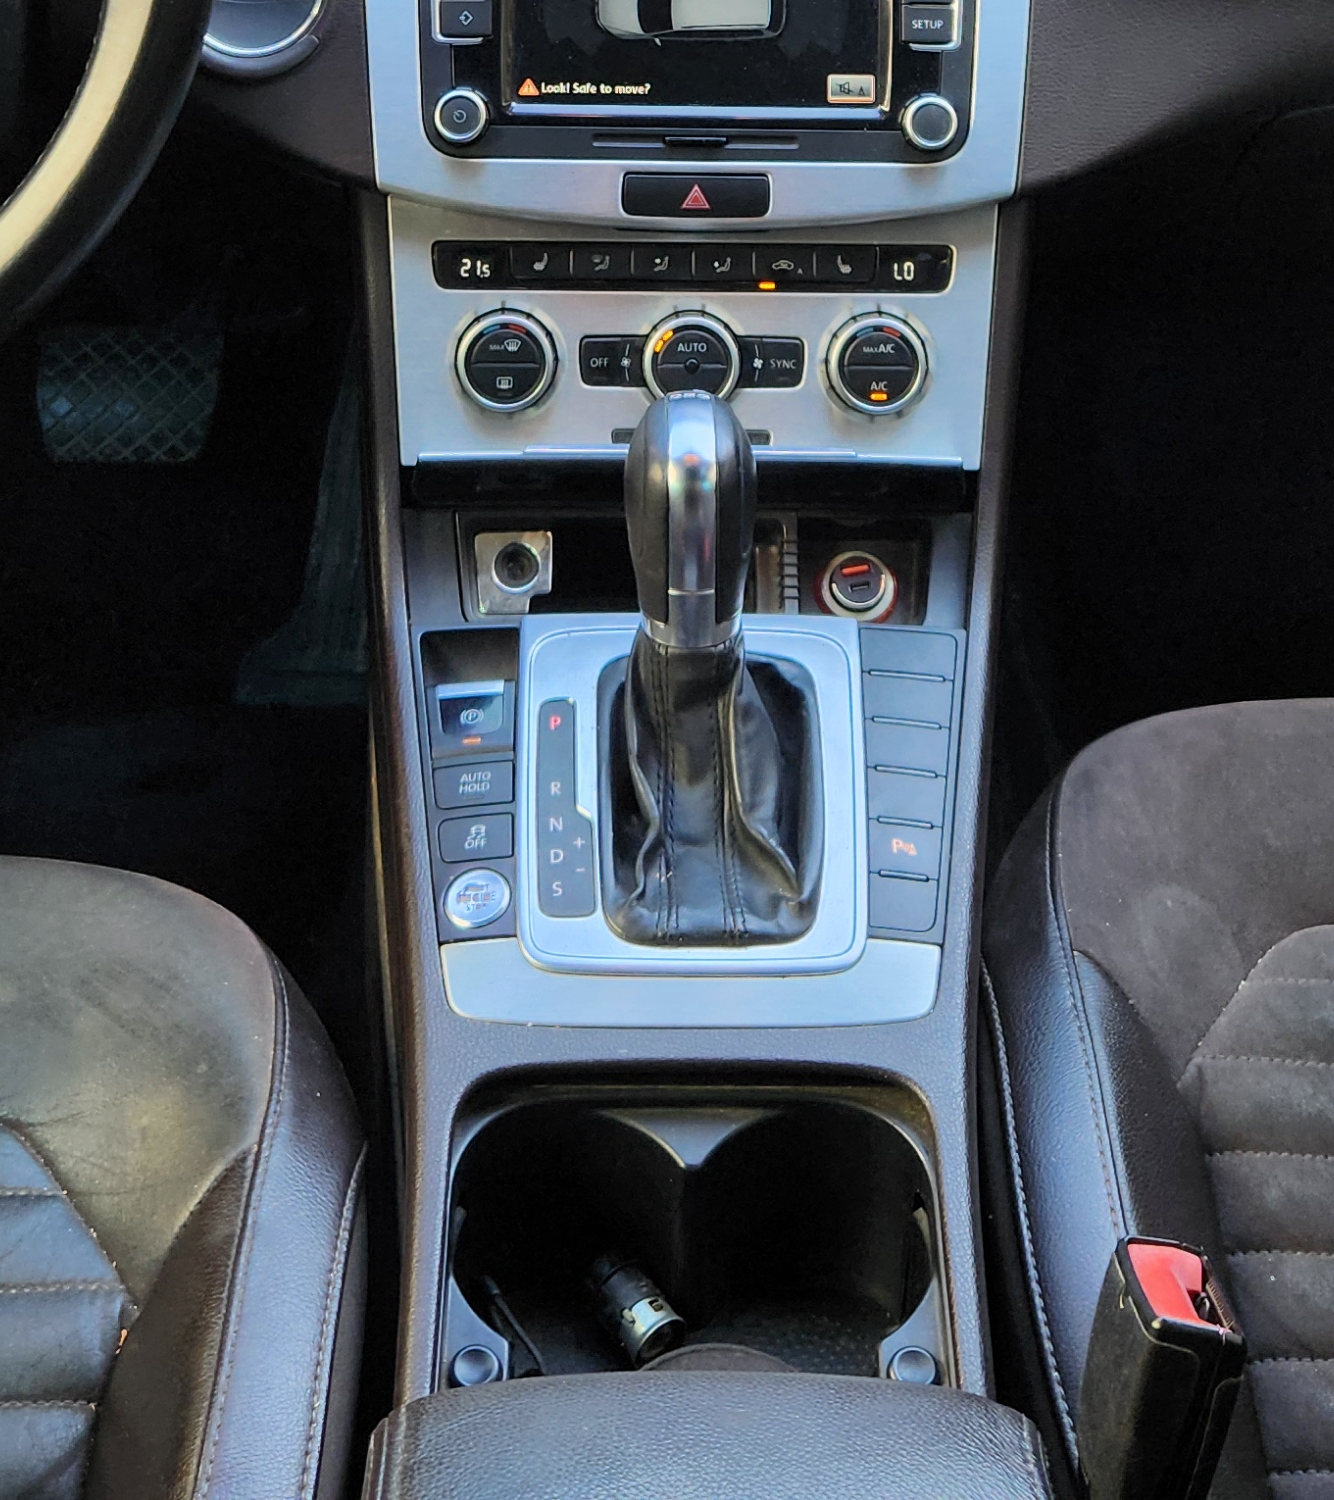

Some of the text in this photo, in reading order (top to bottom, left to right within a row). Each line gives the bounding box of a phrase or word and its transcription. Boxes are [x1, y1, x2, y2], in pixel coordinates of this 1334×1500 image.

[911, 19, 944, 29] SETUP
[541, 81, 651, 95] Look! Safe to move?
[677, 342, 707, 353] AUTO
[878, 343, 895, 354] A/C
[590, 357, 610, 368] OFF
[769, 358, 797, 370] SYNC
[870, 380, 888, 391] A/C
[549, 715, 562, 731] P
[460, 771, 492, 784] AUTO
[458, 782, 490, 794] HOLD
[551, 781, 561, 795] R
[549, 817, 563, 832] N
[464, 837, 487, 850] OFF
[550, 849, 564, 864] D
[552, 881, 563, 896] S
